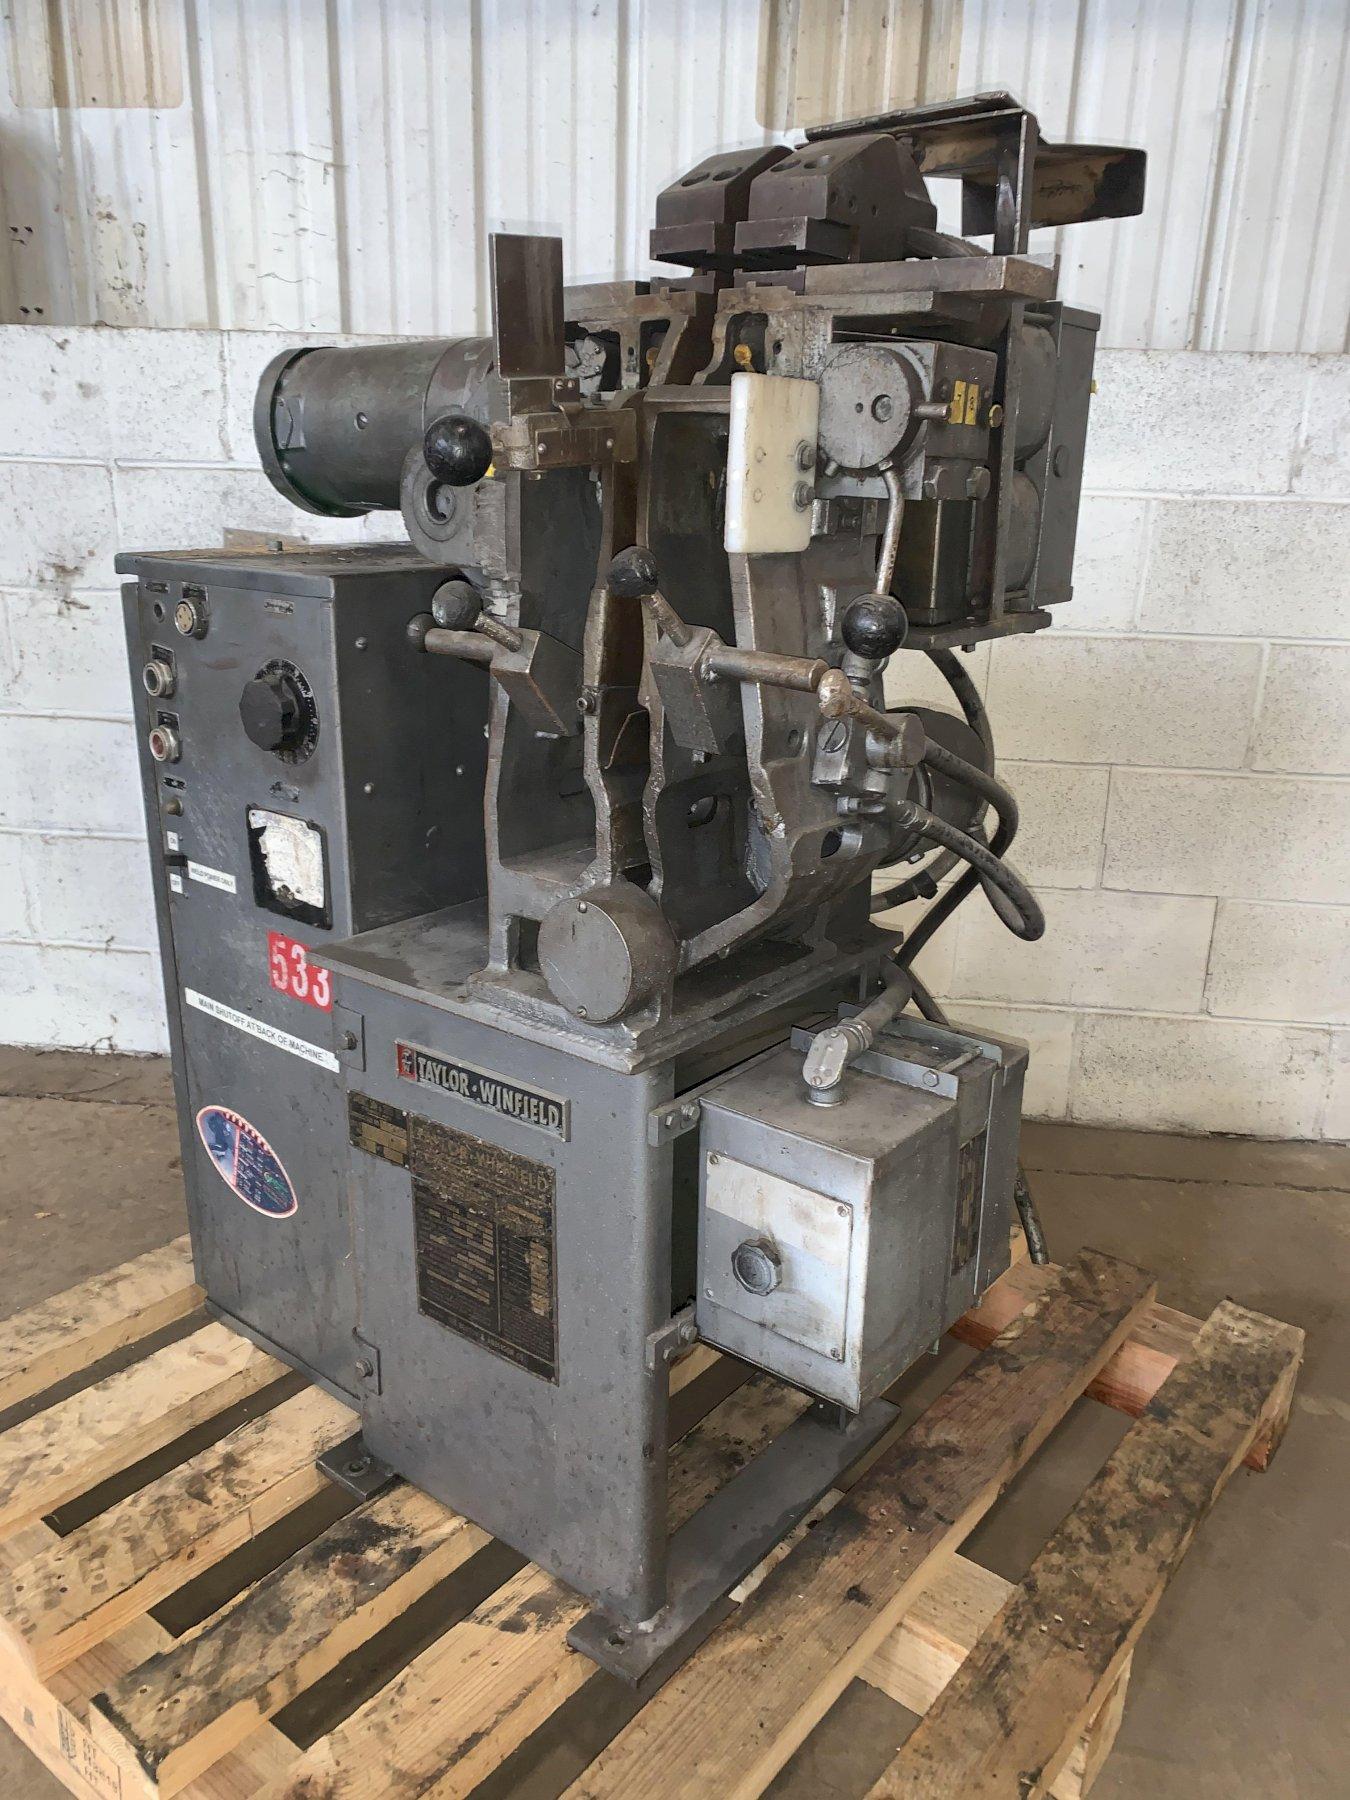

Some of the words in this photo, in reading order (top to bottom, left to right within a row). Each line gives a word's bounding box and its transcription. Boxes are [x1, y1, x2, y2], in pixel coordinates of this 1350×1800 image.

[272, 940, 329, 1007] 533
[198, 997, 214, 1012] MAIN
[216, 1005, 245, 1026] SHUTOFF
[246, 1020, 256, 1030] AT
[256, 1024, 276, 1040] BACK
[277, 1034, 288, 1046] OF
[288, 1040, 324, 1062] MACHINE
